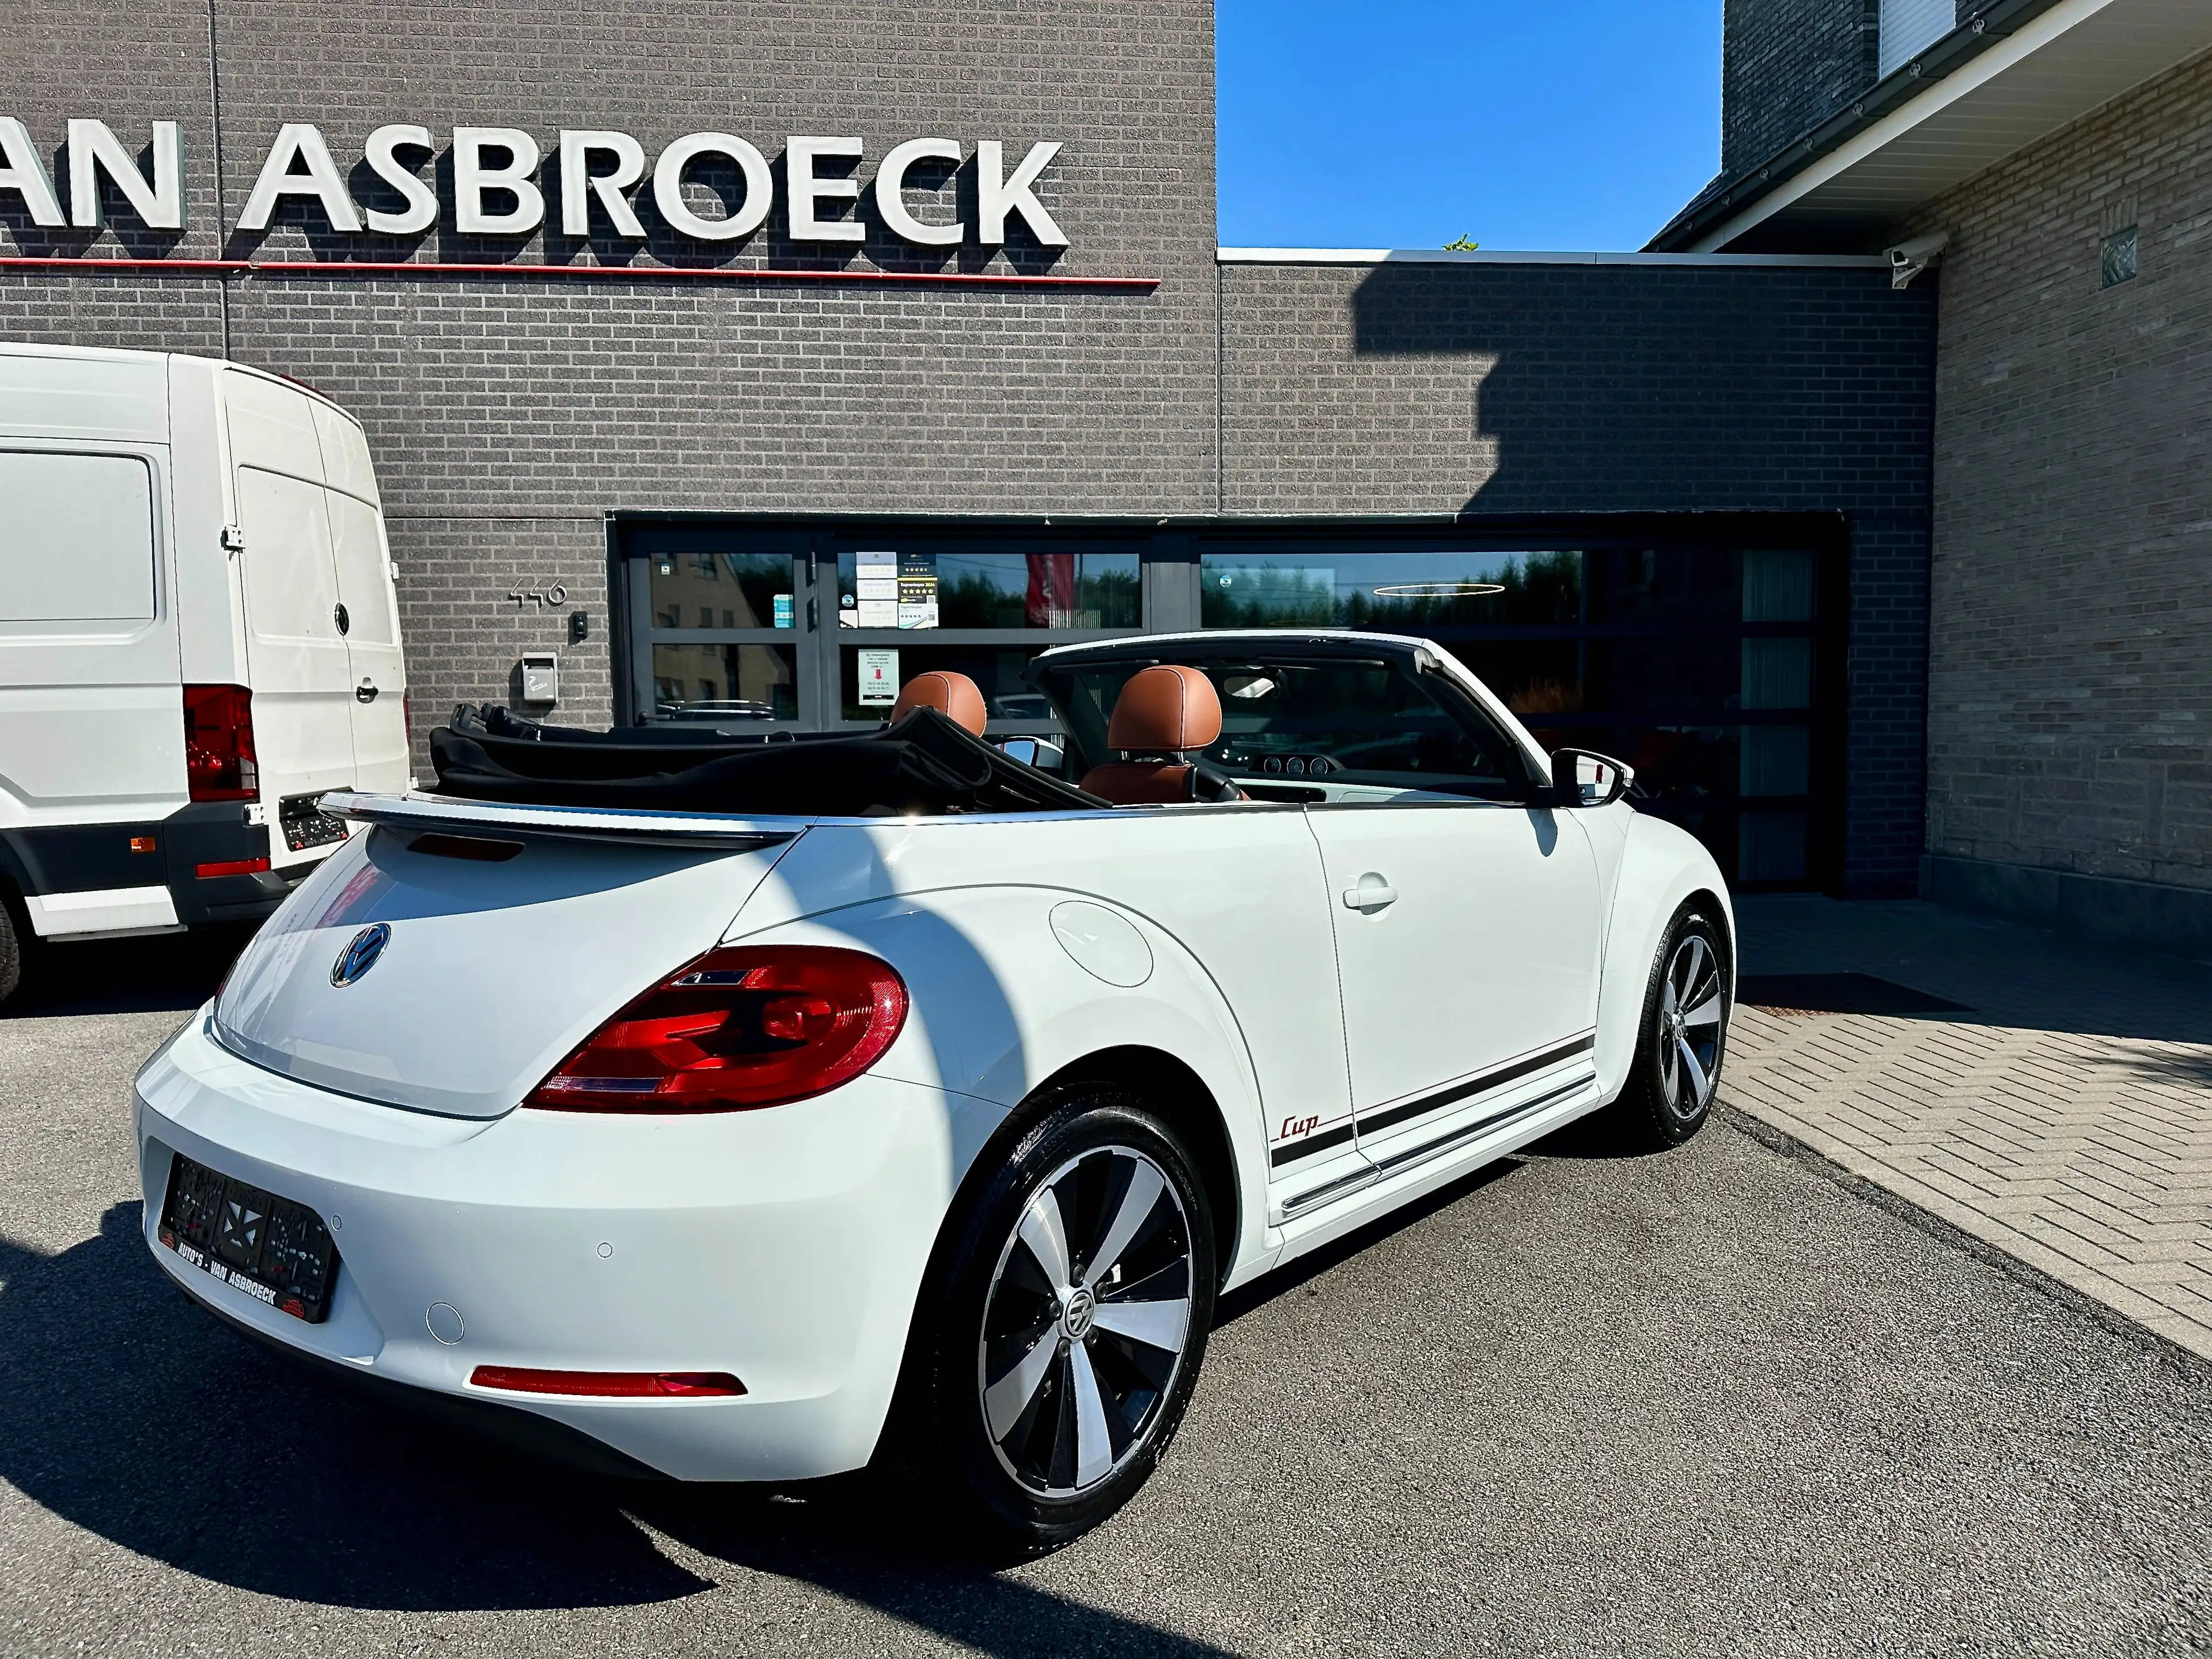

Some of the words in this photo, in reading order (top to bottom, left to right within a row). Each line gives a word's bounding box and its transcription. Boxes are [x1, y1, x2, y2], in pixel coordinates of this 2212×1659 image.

[234, 123, 1070, 246] ASBROECK
[1281, 1115, 1319, 1139] Cup
[177, 1242, 204, 1267] AUTO'S
[210, 1260, 228, 1281] VAN
[228, 1271, 277, 1305] ASBROECK
